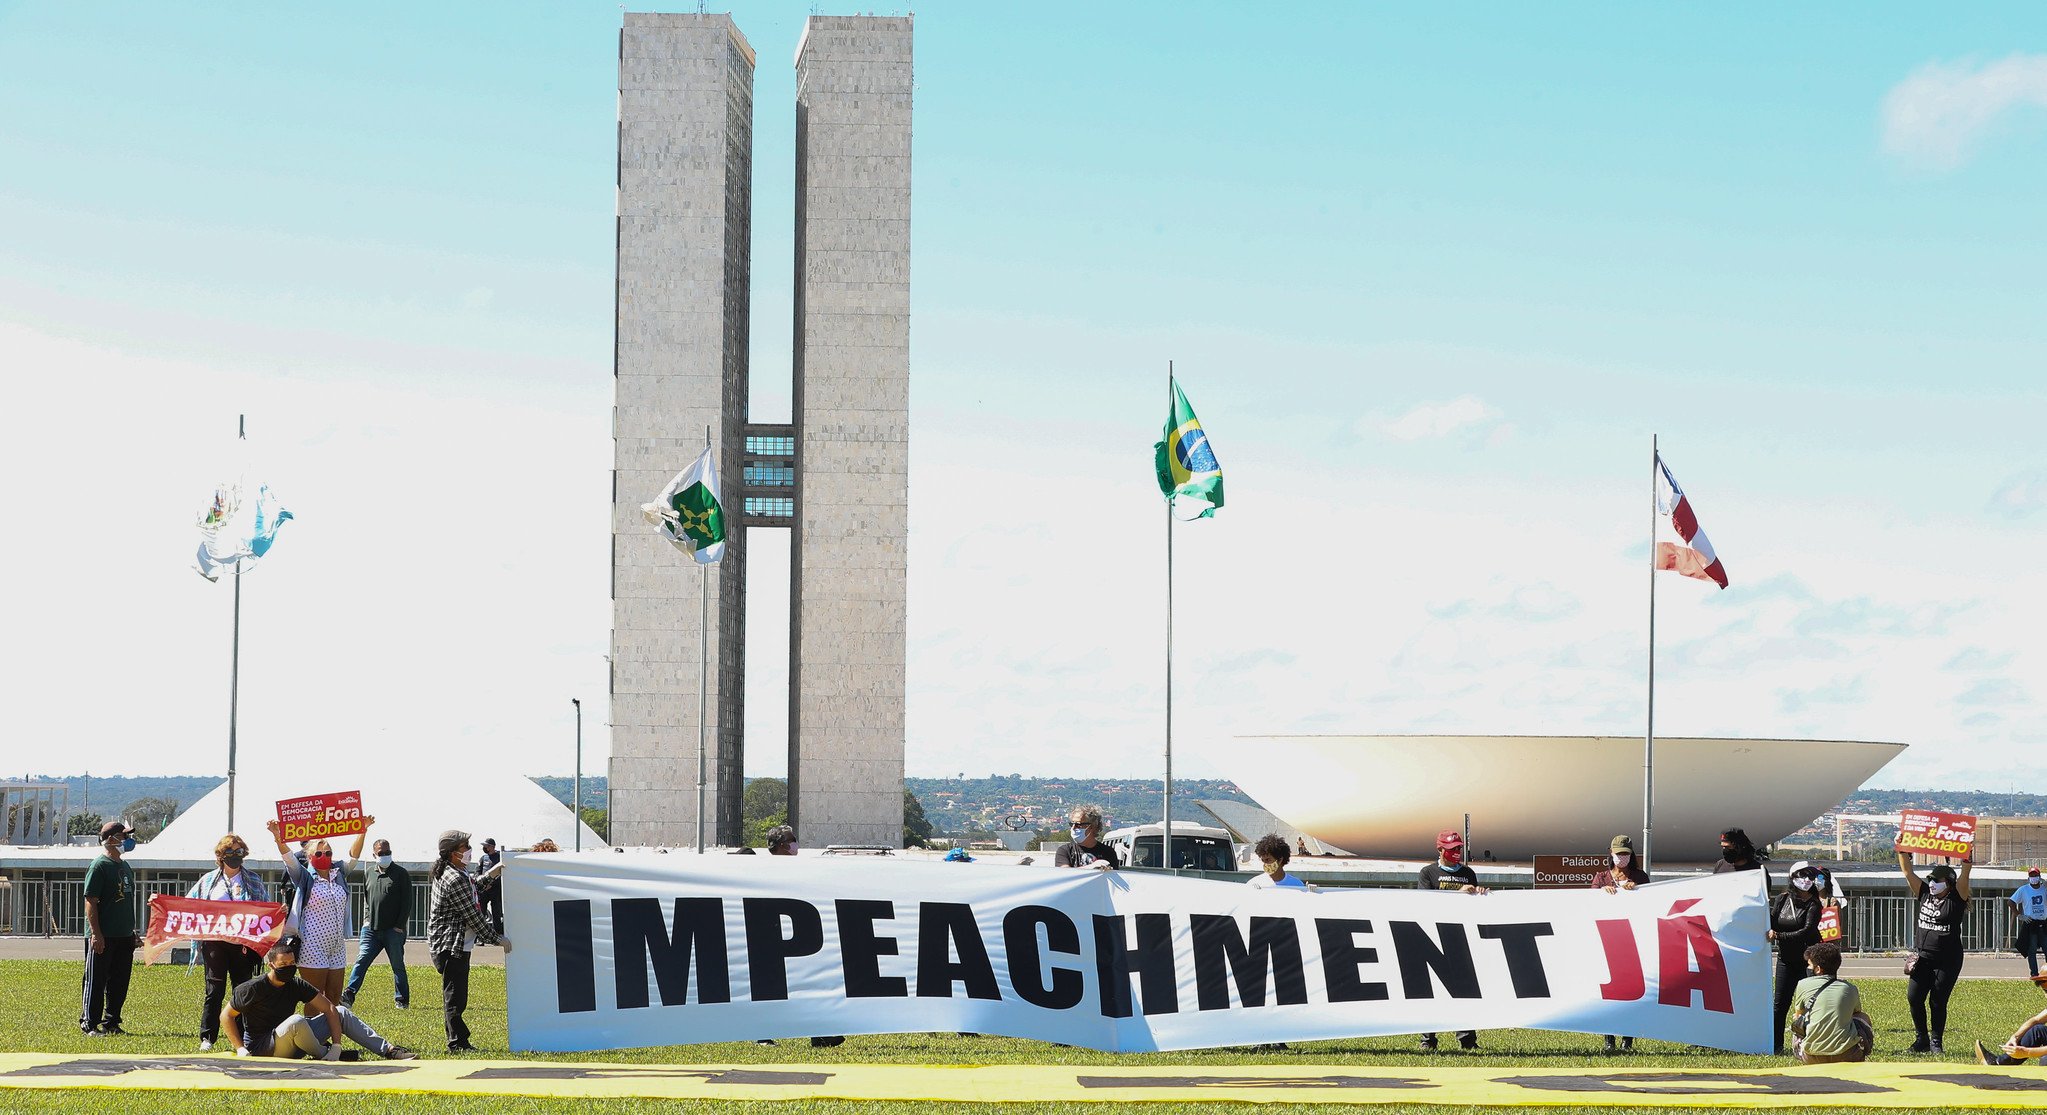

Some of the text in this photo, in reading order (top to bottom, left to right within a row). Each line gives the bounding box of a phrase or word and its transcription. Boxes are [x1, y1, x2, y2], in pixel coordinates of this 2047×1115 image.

[282, 805, 322, 816] DEMOCRACIA
[291, 800, 314, 809] DEFESA
[315, 806, 360, 823] #Fora
[285, 819, 362, 839] Bolsonaro
[1928, 825, 1970, 842] #Fora
[1901, 832, 1968, 854] Bolsonaro
[1562, 857, 1610, 867] Palácio d
[1536, 871, 1594, 883] Congresso
[163, 910, 273, 937] FENASPS
[1817, 918, 1837, 931] ora
[554, 898, 1731, 1018] IMPEACHMENT JÁ
